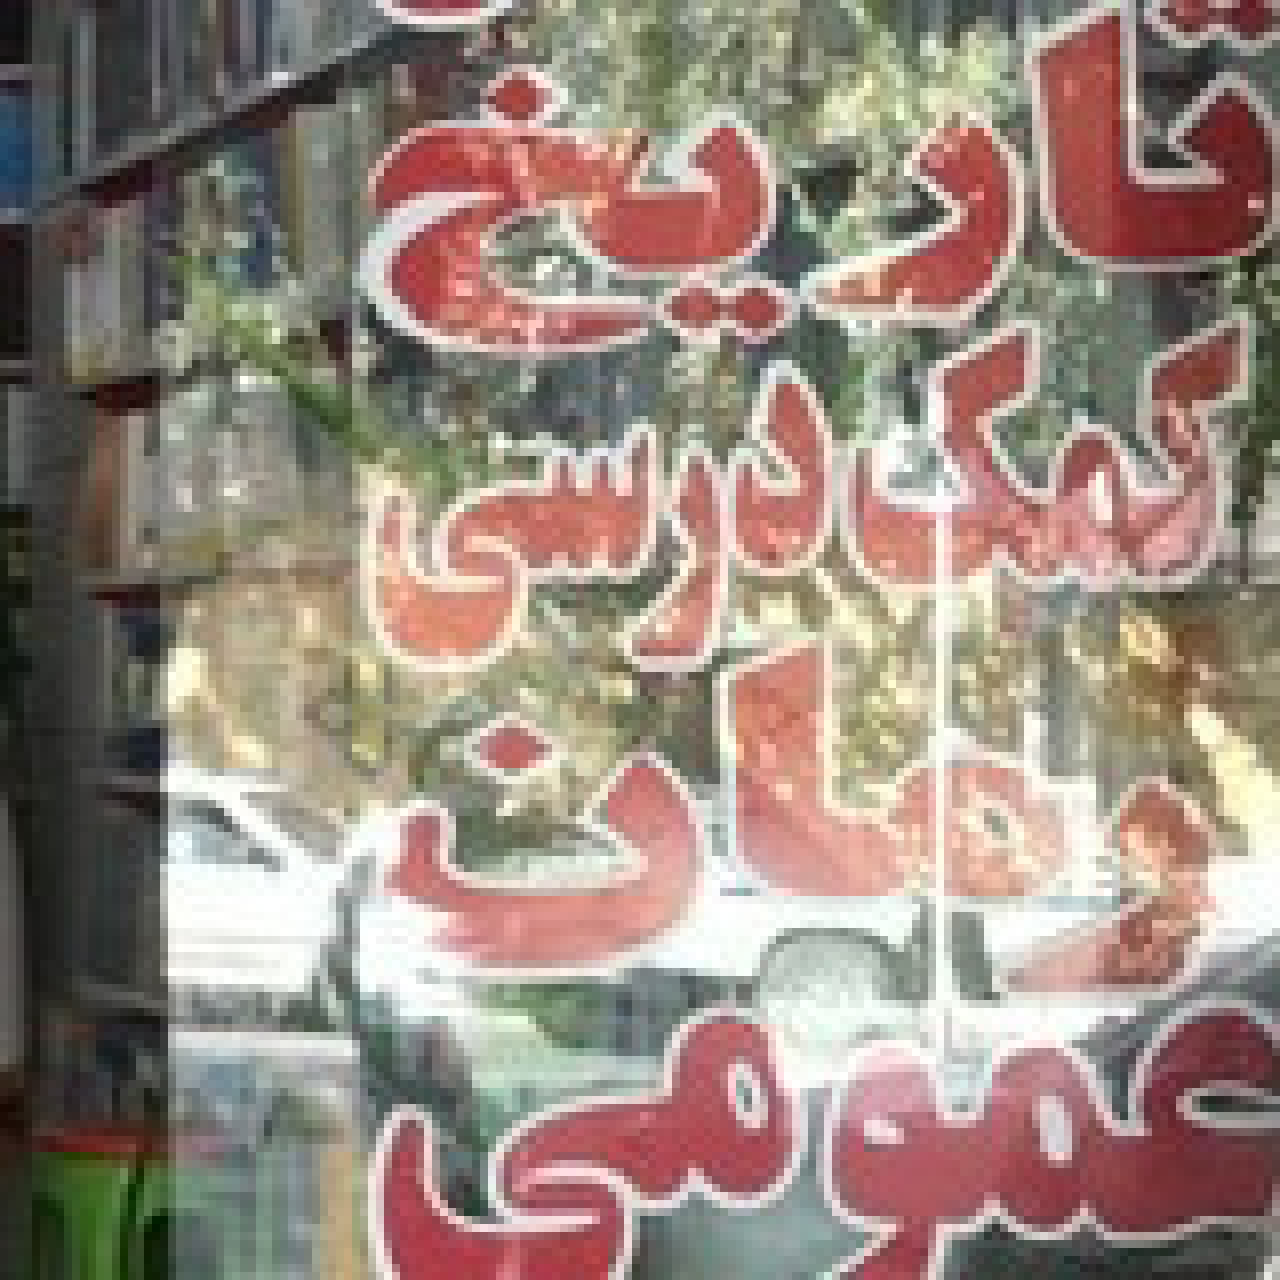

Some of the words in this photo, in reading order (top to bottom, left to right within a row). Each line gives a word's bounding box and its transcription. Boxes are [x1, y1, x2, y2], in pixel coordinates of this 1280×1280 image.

[358, 356, 836, 672] درسی
[843, 318, 1250, 593] کمک
[378, 638, 1220, 998] رمان
